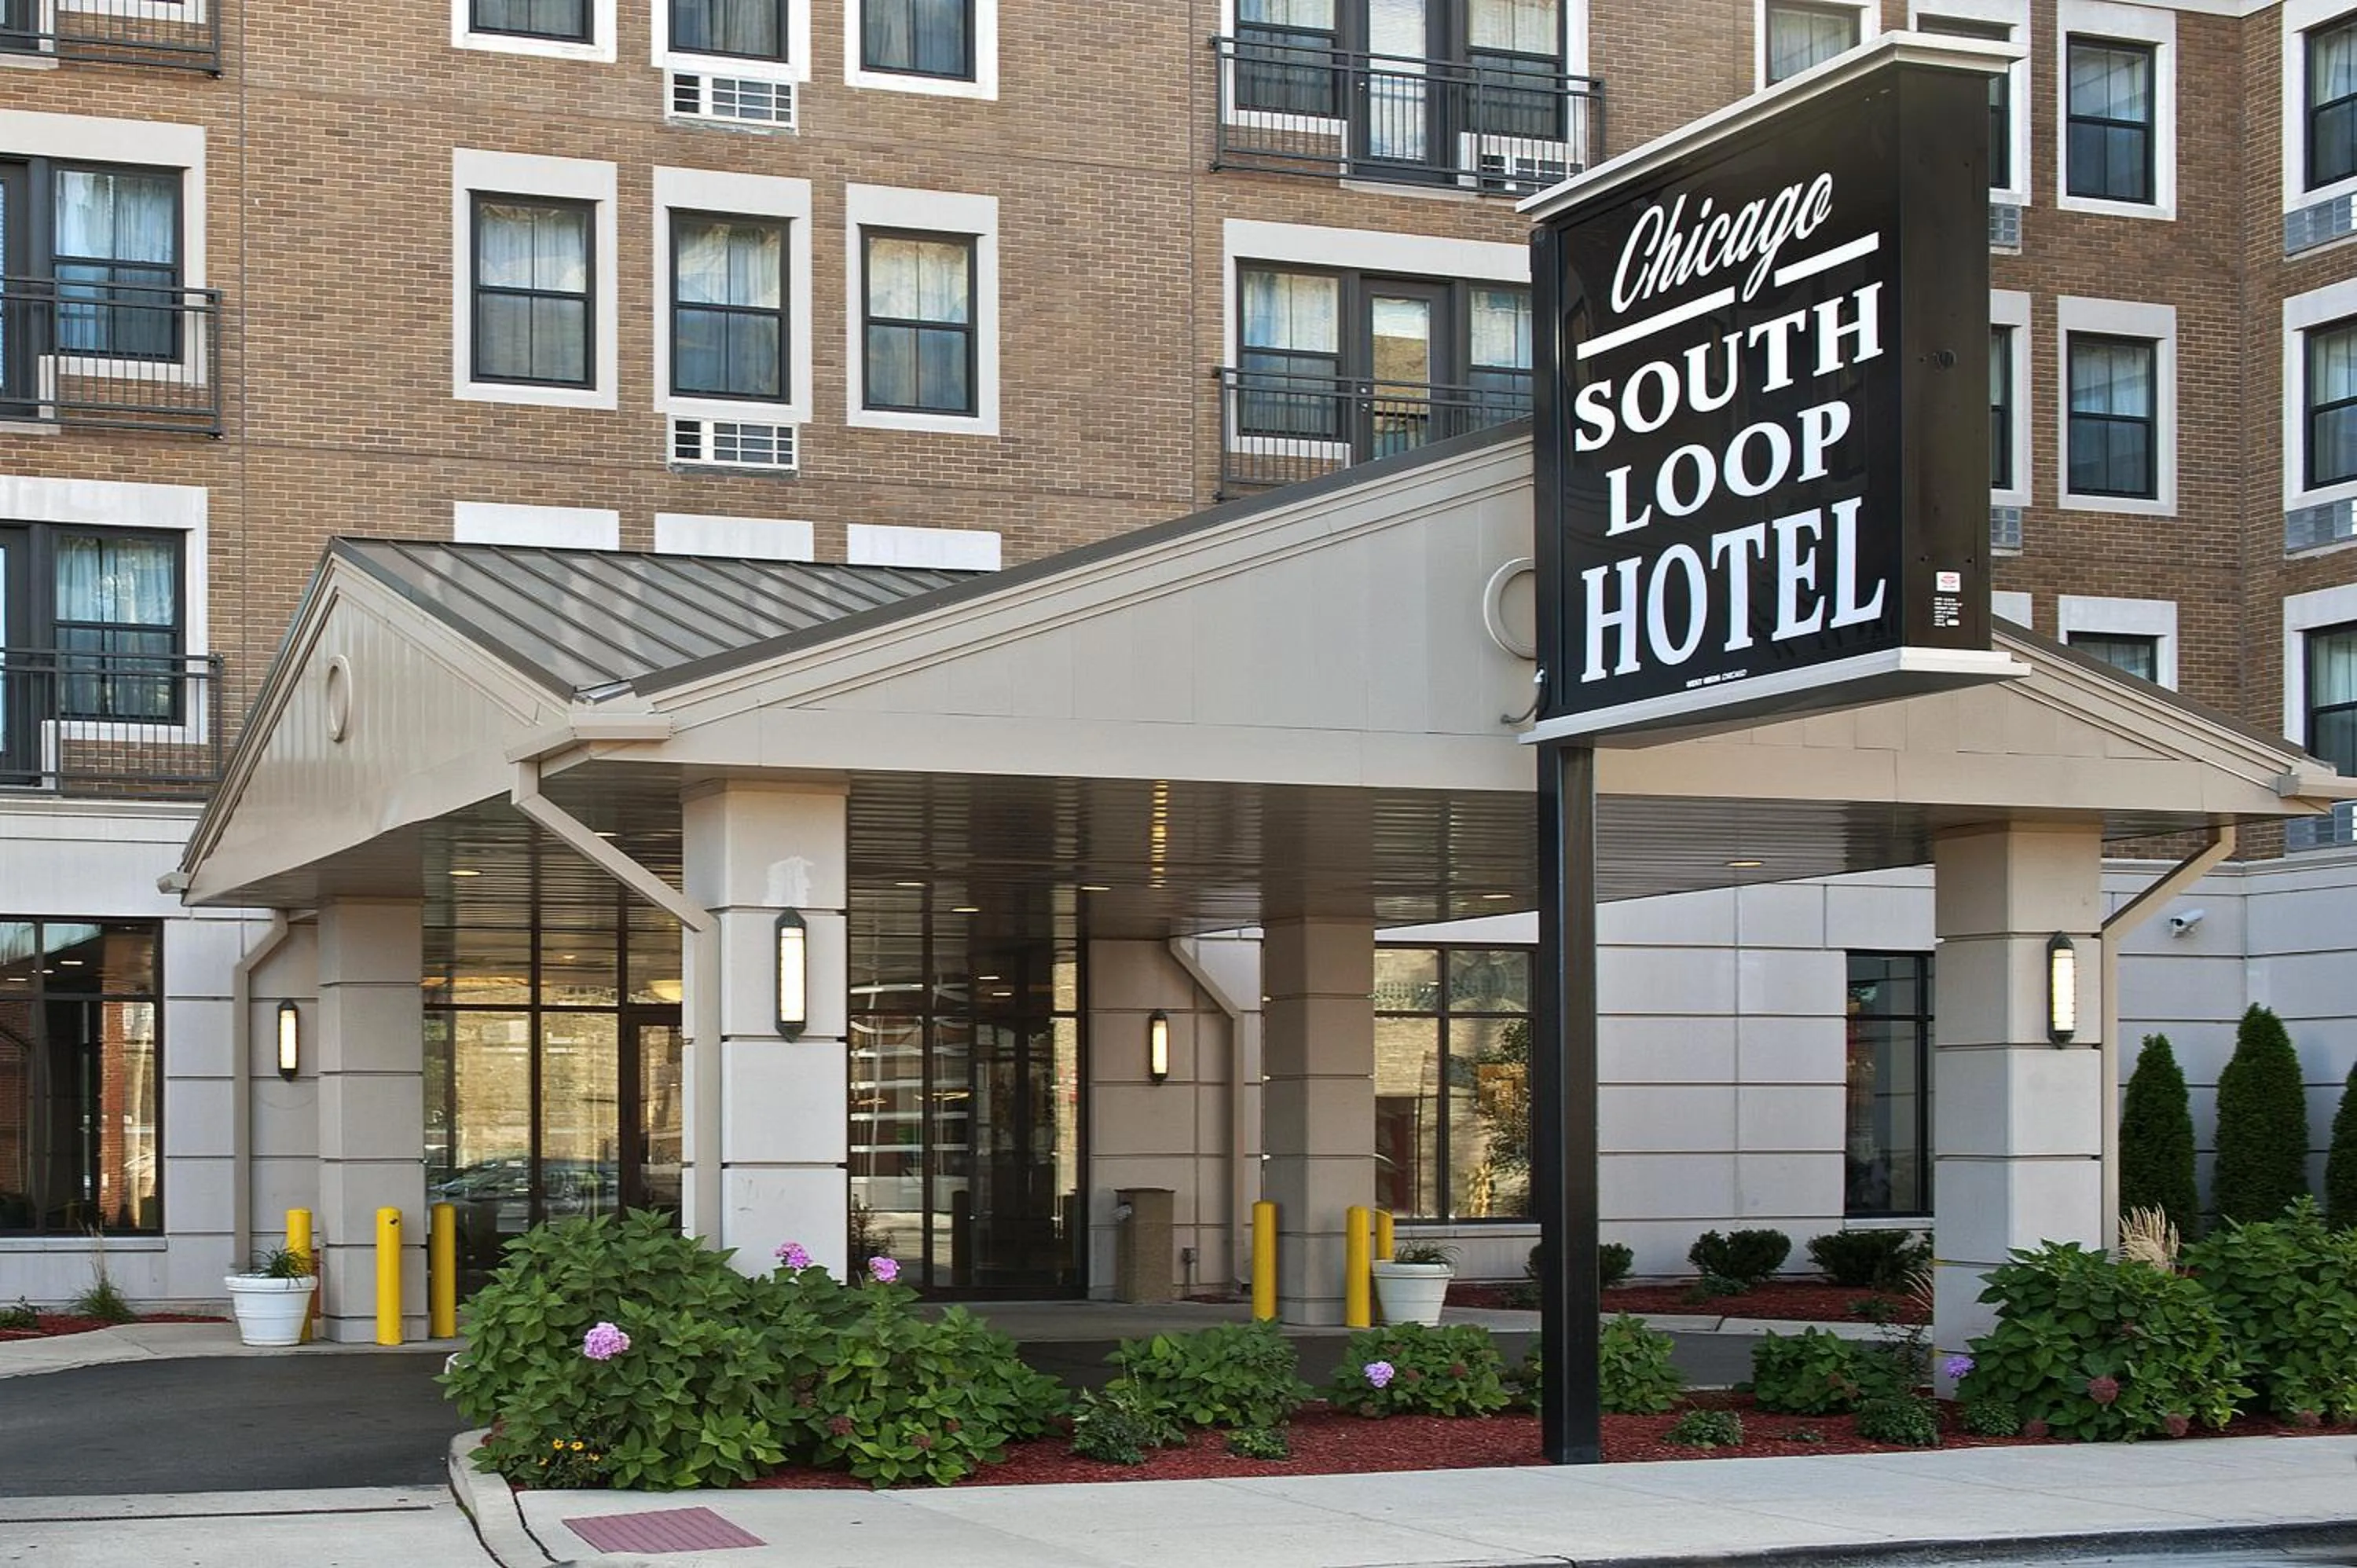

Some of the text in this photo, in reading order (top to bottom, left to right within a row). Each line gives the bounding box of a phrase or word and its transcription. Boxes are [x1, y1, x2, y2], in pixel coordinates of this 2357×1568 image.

[1612, 173, 1833, 313] Chicago
[1575, 282, 1883, 451] SOUTH
[1606, 401, 1851, 536] LOOP
[1582, 496, 1886, 682] HOTEL
